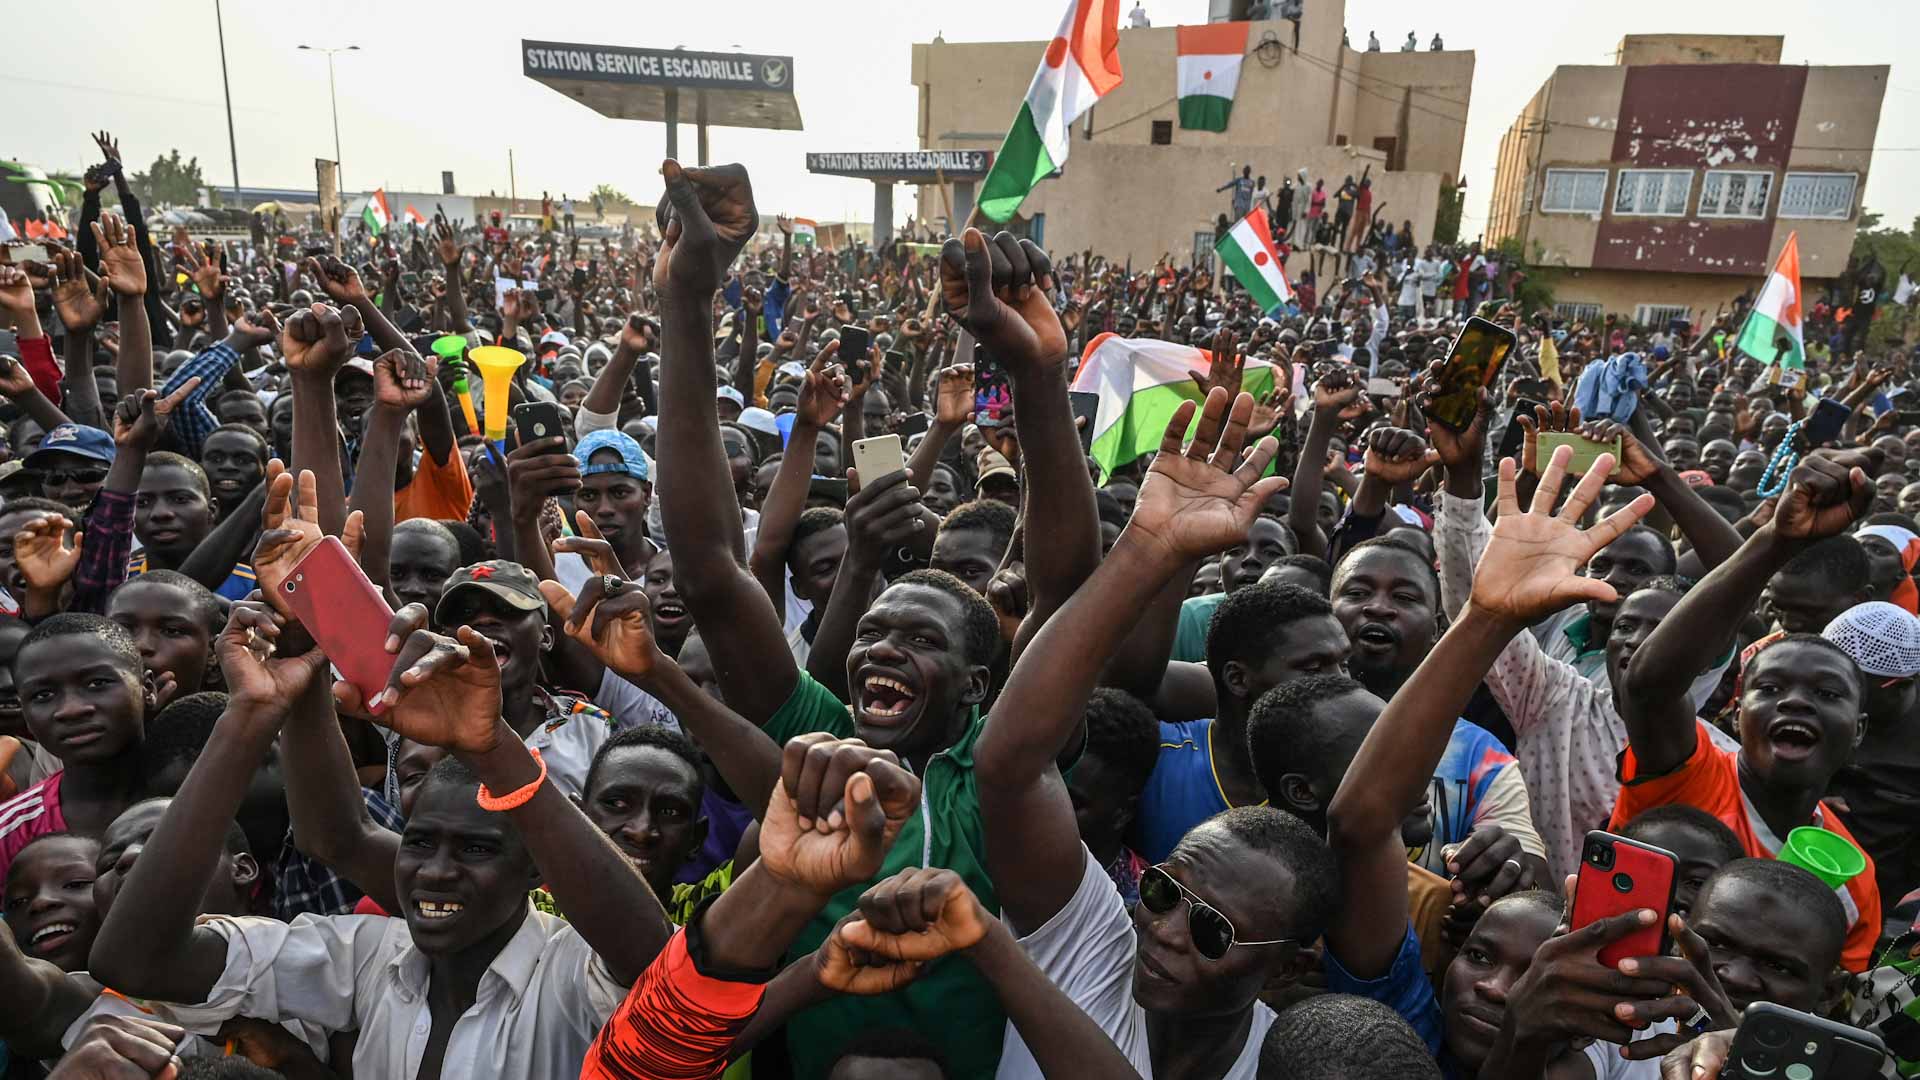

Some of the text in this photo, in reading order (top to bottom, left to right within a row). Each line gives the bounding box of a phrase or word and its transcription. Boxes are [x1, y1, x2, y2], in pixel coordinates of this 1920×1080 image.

[527, 48, 754, 81] STATION SERVICE ESCADRILLE
[819, 151, 970, 170] STATION SERVICE ESCADRILLE
